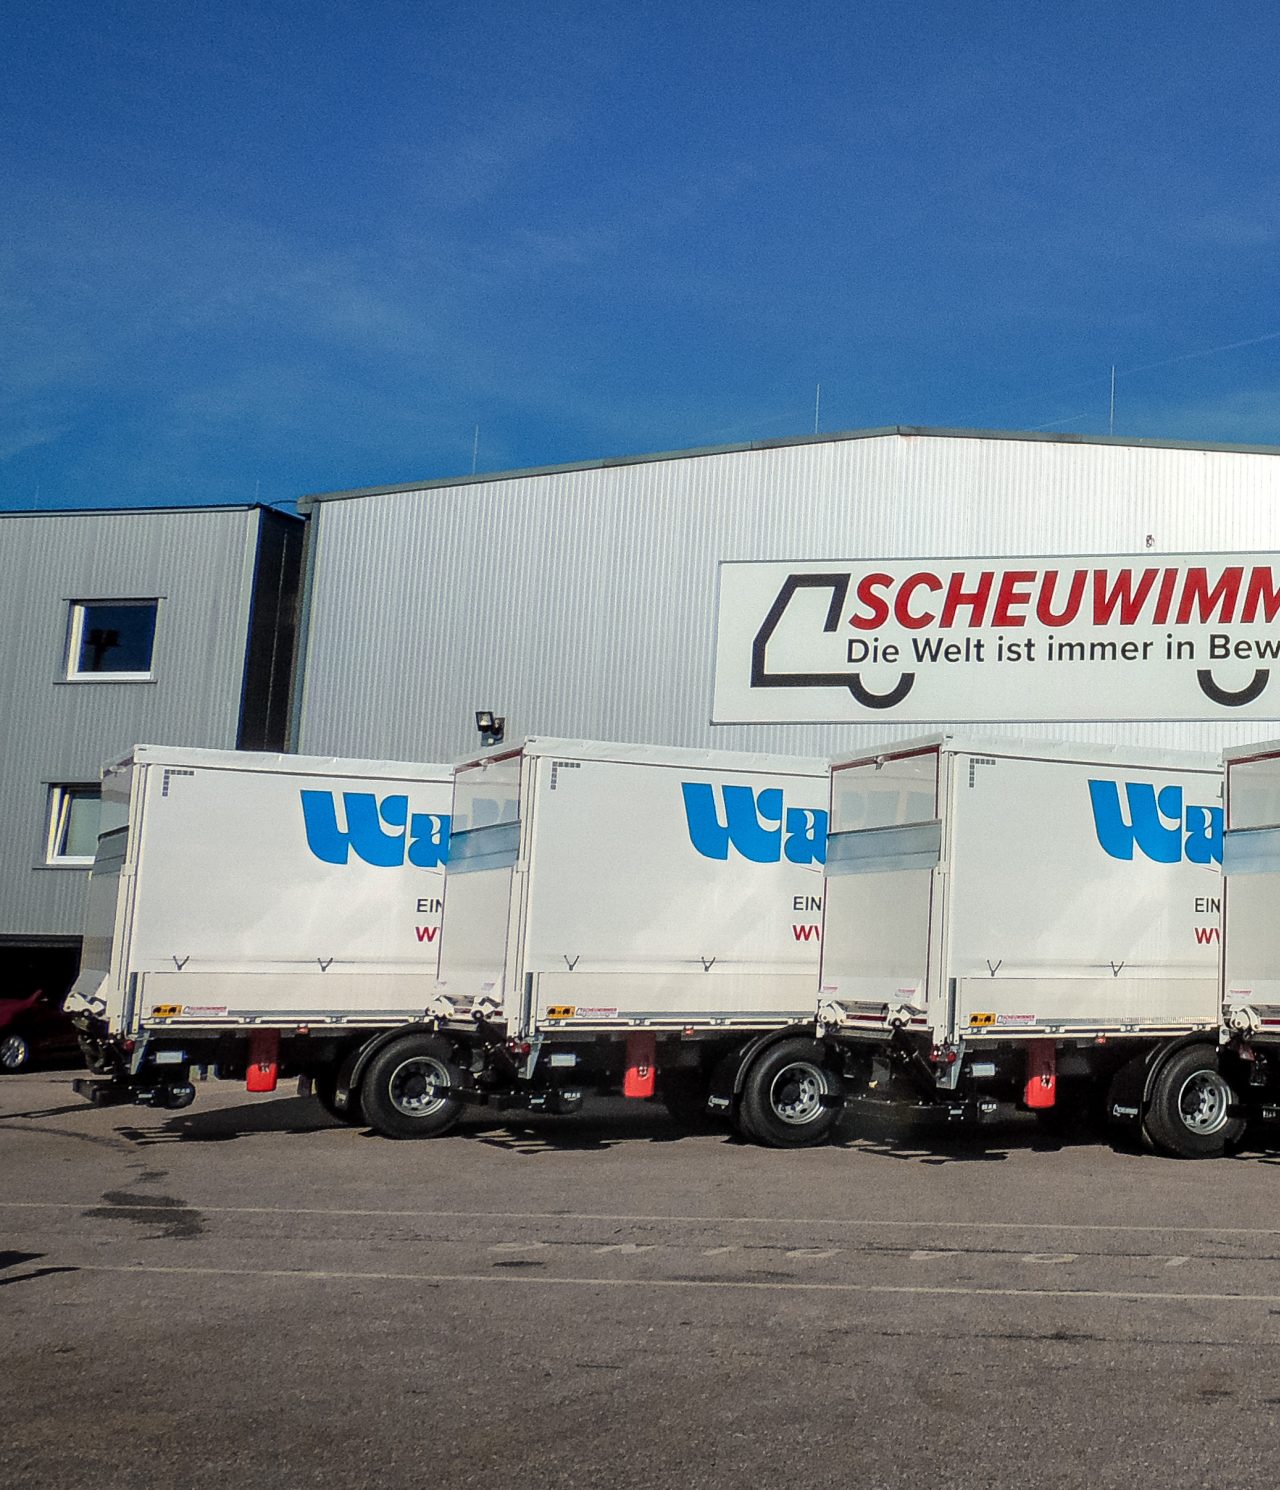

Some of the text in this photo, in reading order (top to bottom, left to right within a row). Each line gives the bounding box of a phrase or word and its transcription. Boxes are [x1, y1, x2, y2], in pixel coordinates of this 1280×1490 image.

[846, 637, 900, 663] Die
[912, 637, 985, 663] Welt
[998, 635, 1036, 662] ist
[1047, 634, 1154, 661] immer
[1166, 633, 1195, 660] in
[793, 896, 822, 911] EIN
[1194, 898, 1221, 913] EIN
